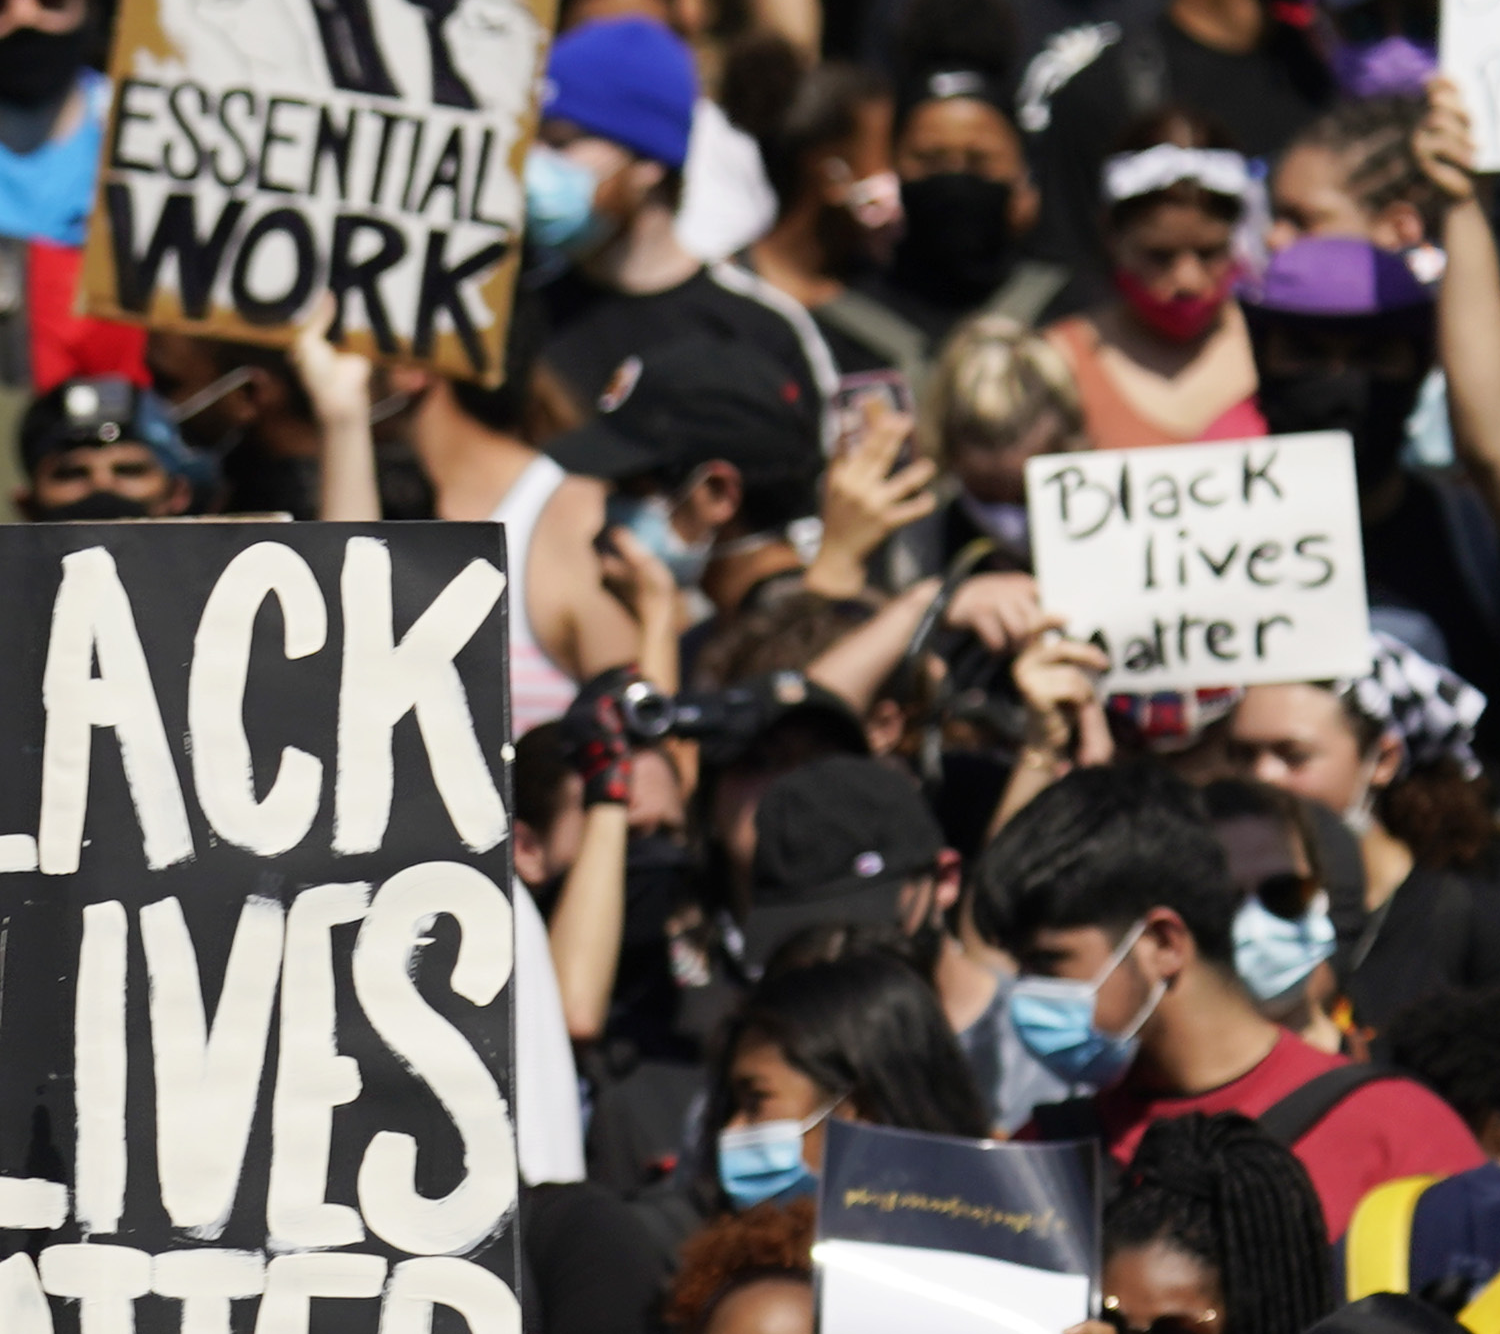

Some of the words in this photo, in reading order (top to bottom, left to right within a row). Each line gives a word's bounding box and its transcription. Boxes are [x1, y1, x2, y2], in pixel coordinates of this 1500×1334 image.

[110, 77, 510, 231] ESSENTIAL
[106, 182, 509, 371] WORK
[1043, 445, 1287, 543] Black
[1143, 526, 1336, 592] lives
